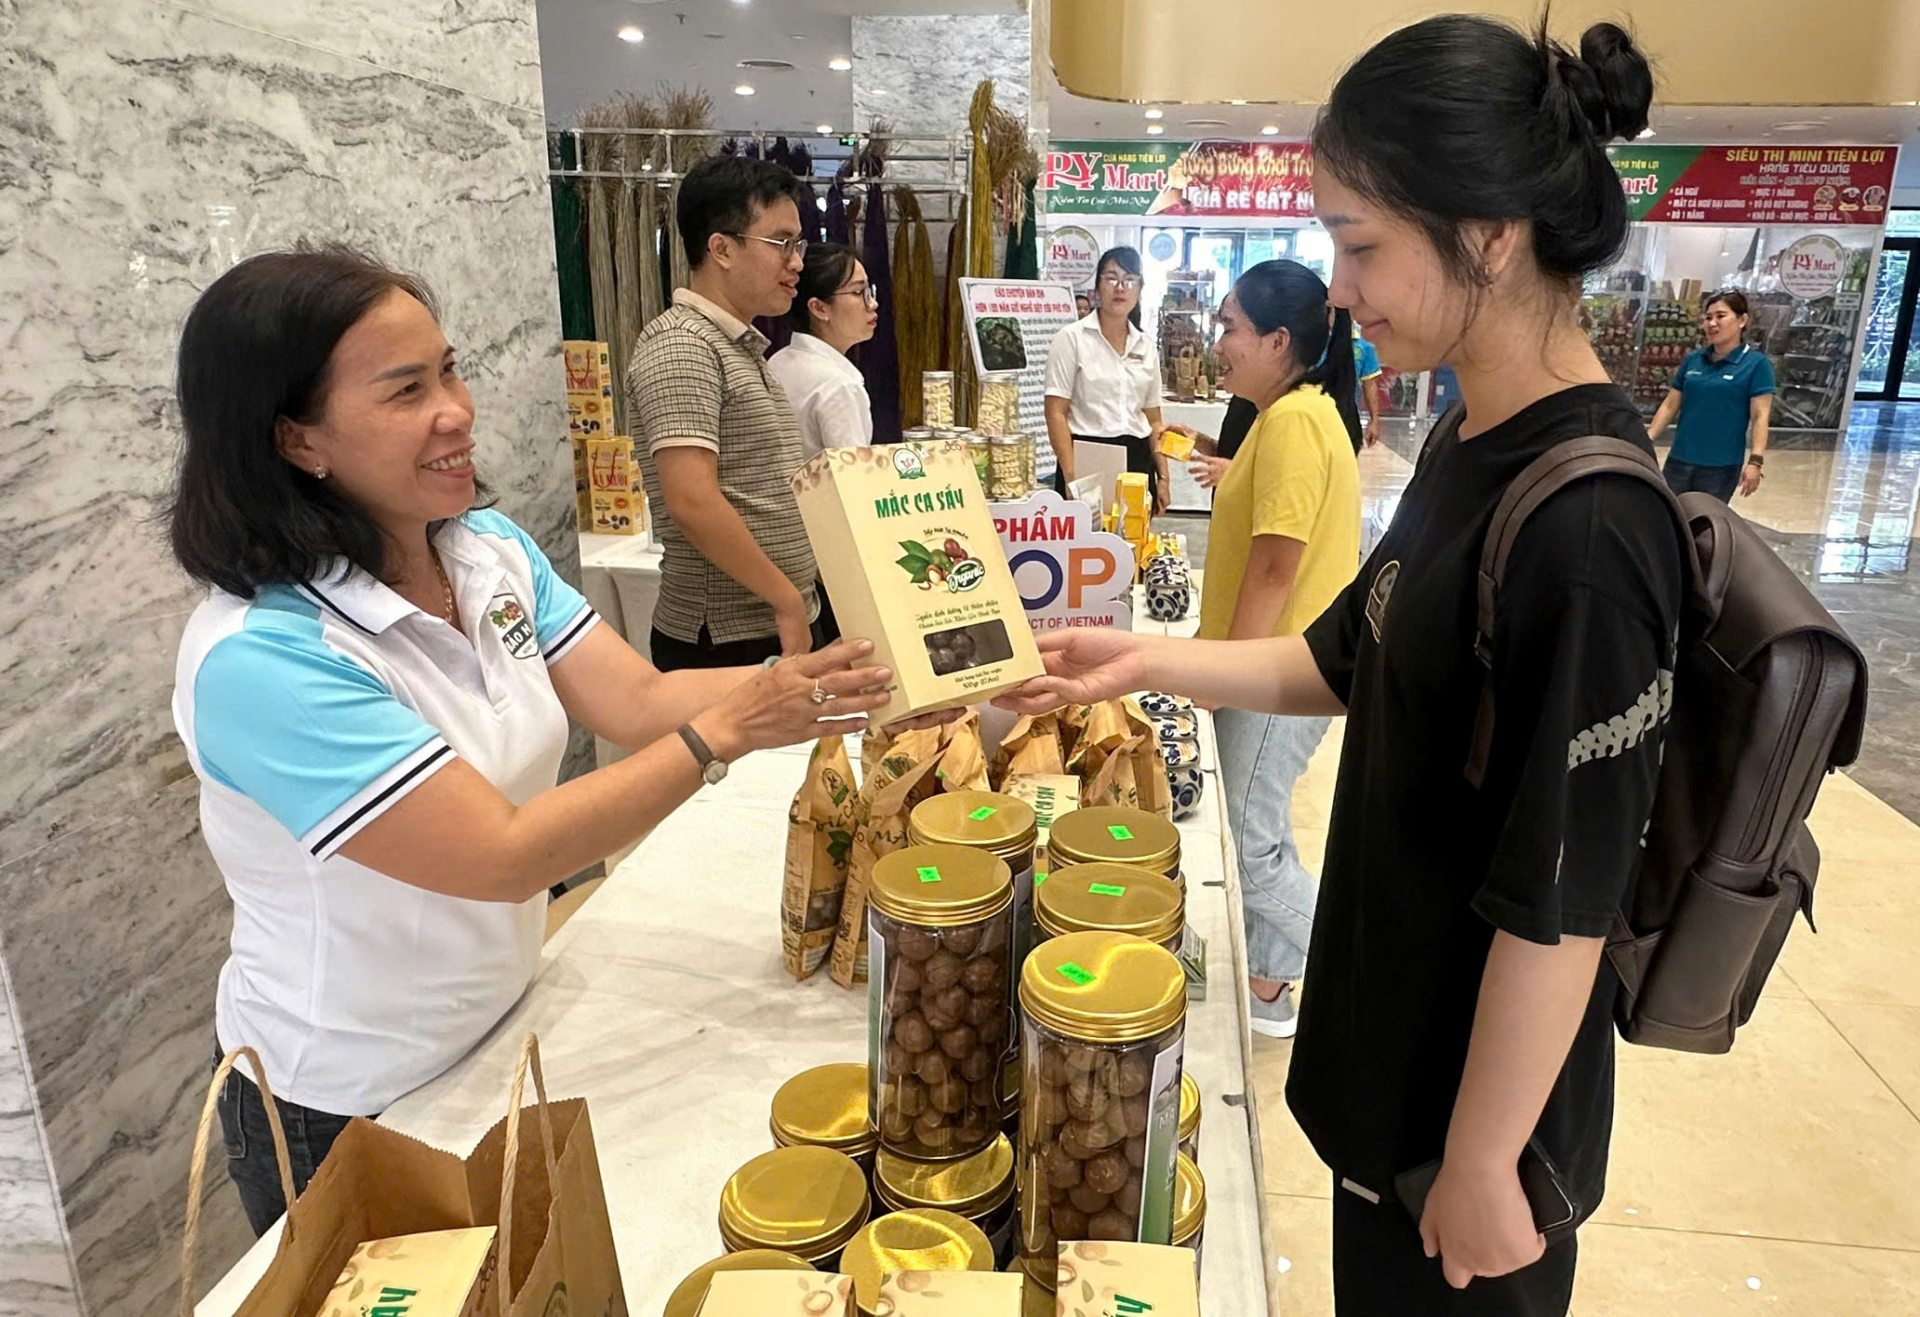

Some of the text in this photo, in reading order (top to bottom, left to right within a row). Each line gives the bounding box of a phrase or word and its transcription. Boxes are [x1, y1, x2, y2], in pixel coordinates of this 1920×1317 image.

[1726, 148, 1885, 165] SIÊU THỊ MINI TIỆN LỢI
[1759, 162, 1790, 173] HÀNG
[1102, 164, 1167, 191] Mart
[1620, 174, 1658, 195] art
[1193, 186, 1221, 208] GIÁ
[1226, 184, 1251, 209] RẺ
[875, 483, 964, 518] MẮC CA SẤY
[993, 505, 1075, 542] PHẨM
[947, 565, 985, 593] Organic
[1029, 615, 1113, 629] CT OF VIETNAM
